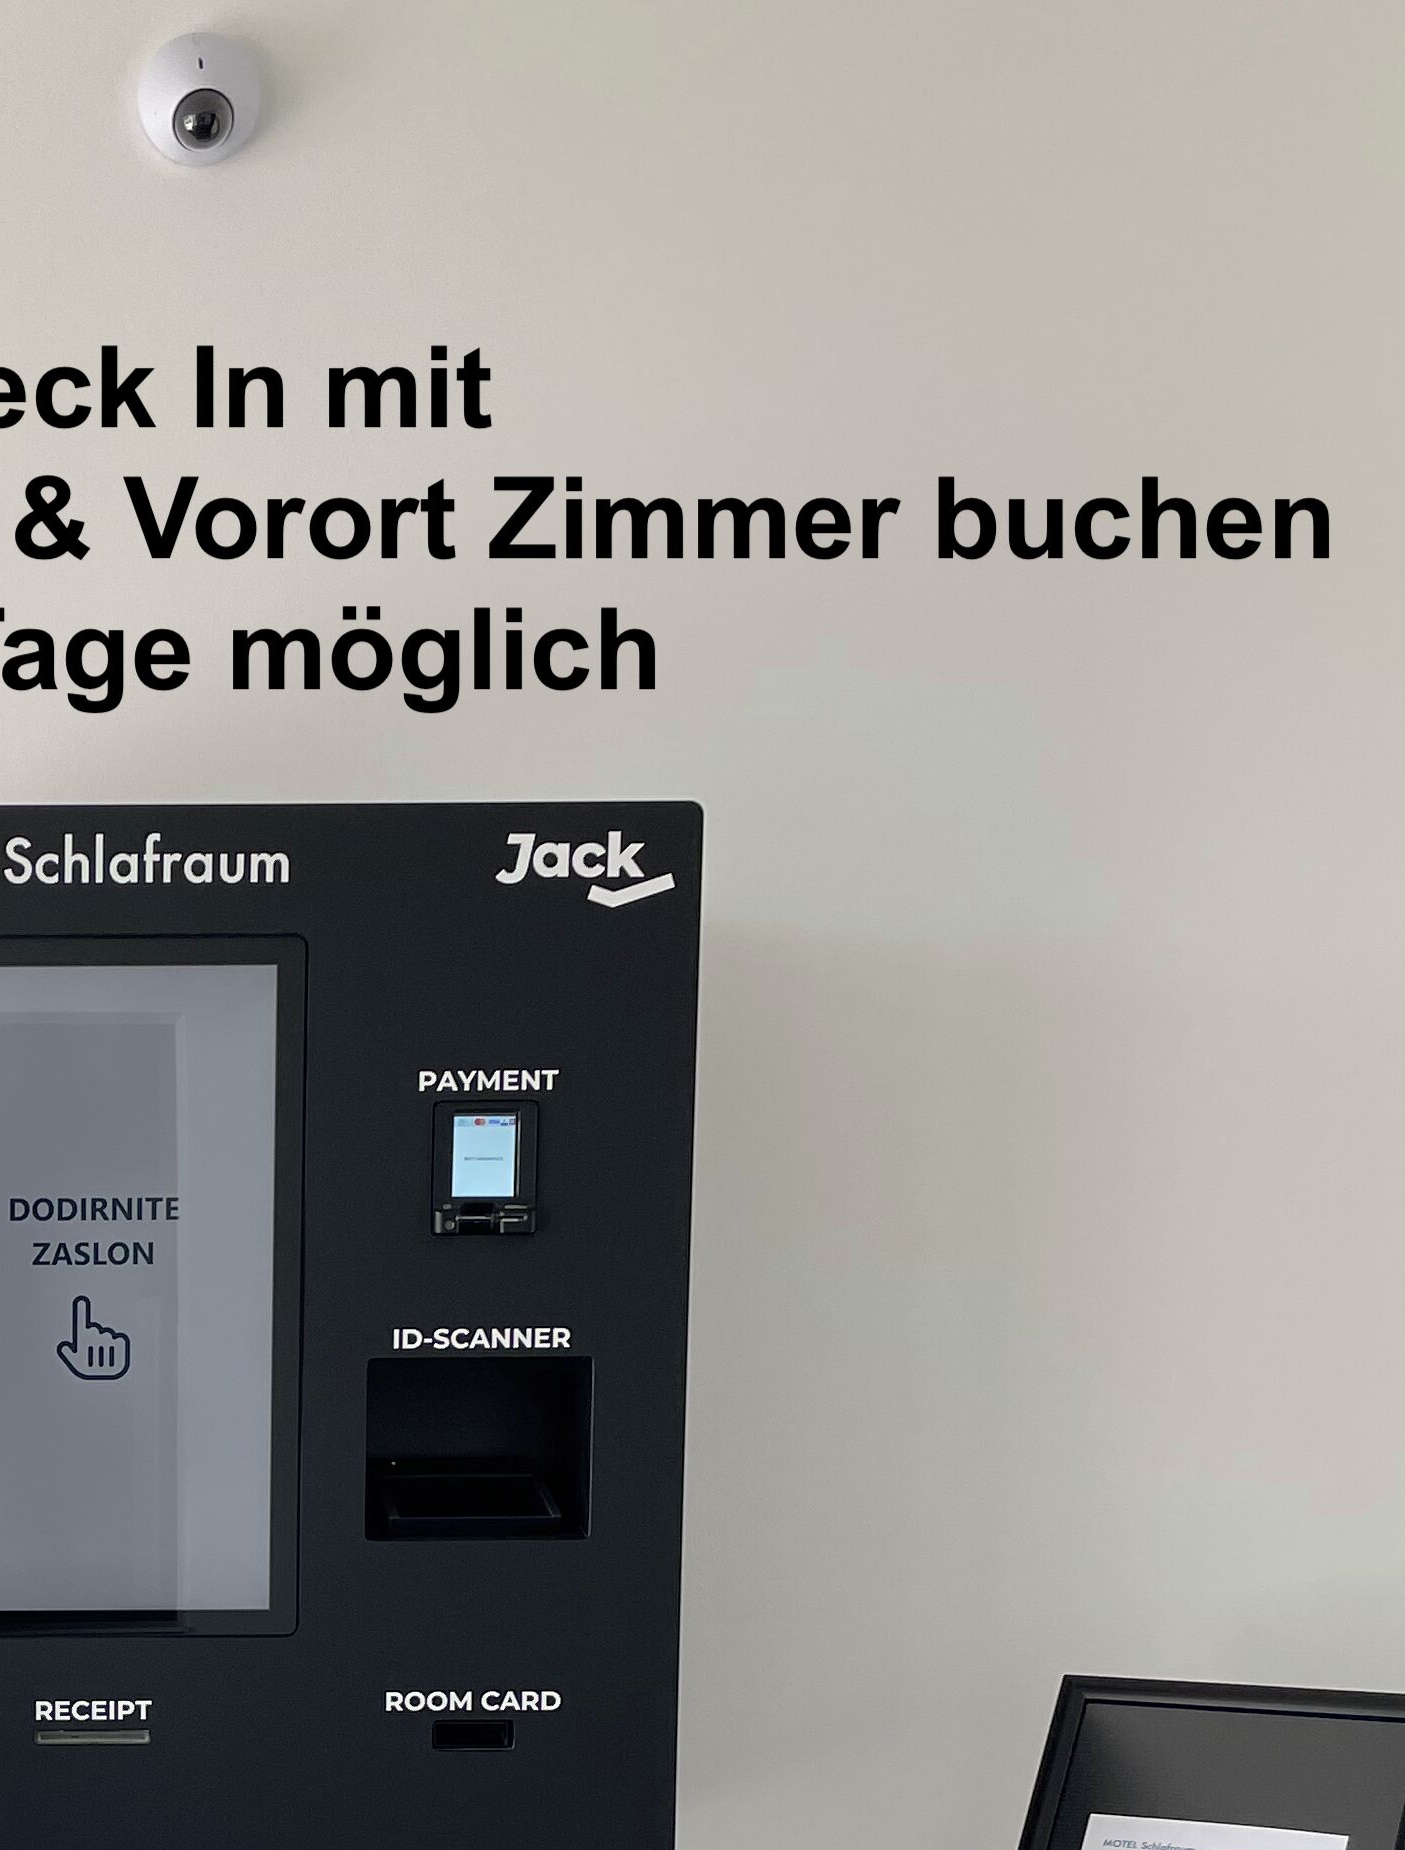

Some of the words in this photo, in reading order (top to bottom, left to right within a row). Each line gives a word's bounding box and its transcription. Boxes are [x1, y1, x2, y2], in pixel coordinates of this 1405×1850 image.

[4, 833, 289, 884] Schlafraum
[496, 831, 645, 885] Jack
[419, 1070, 559, 1091] PAYMENT
[10, 1198, 179, 1221] DODIRNITE
[32, 1242, 153, 1265] ZASLON
[394, 1328, 570, 1349] ID-SCANNER
[36, 1701, 152, 1720] RECEIPT
[386, 1692, 472, 1711] ROOM
[481, 1691, 561, 1710] CARD
[1103, 1839, 1137, 1849] MOTEL
